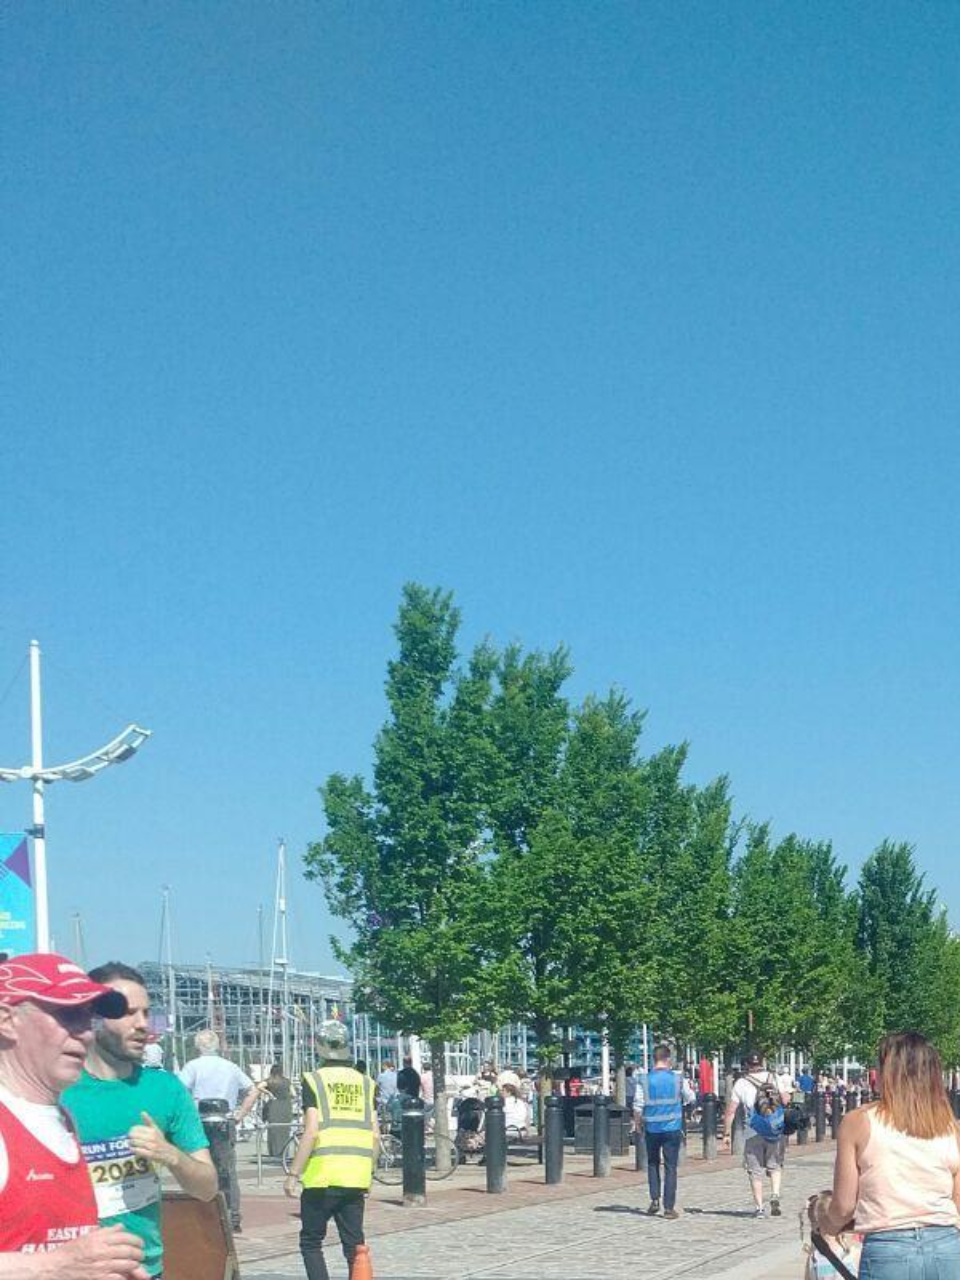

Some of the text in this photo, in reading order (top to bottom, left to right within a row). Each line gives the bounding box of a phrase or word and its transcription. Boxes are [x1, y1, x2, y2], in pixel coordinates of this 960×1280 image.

[327, 1083, 362, 1096] MEDICAL
[81, 1142, 106, 1155] RUN
[47, 1227, 78, 1241] EAST
